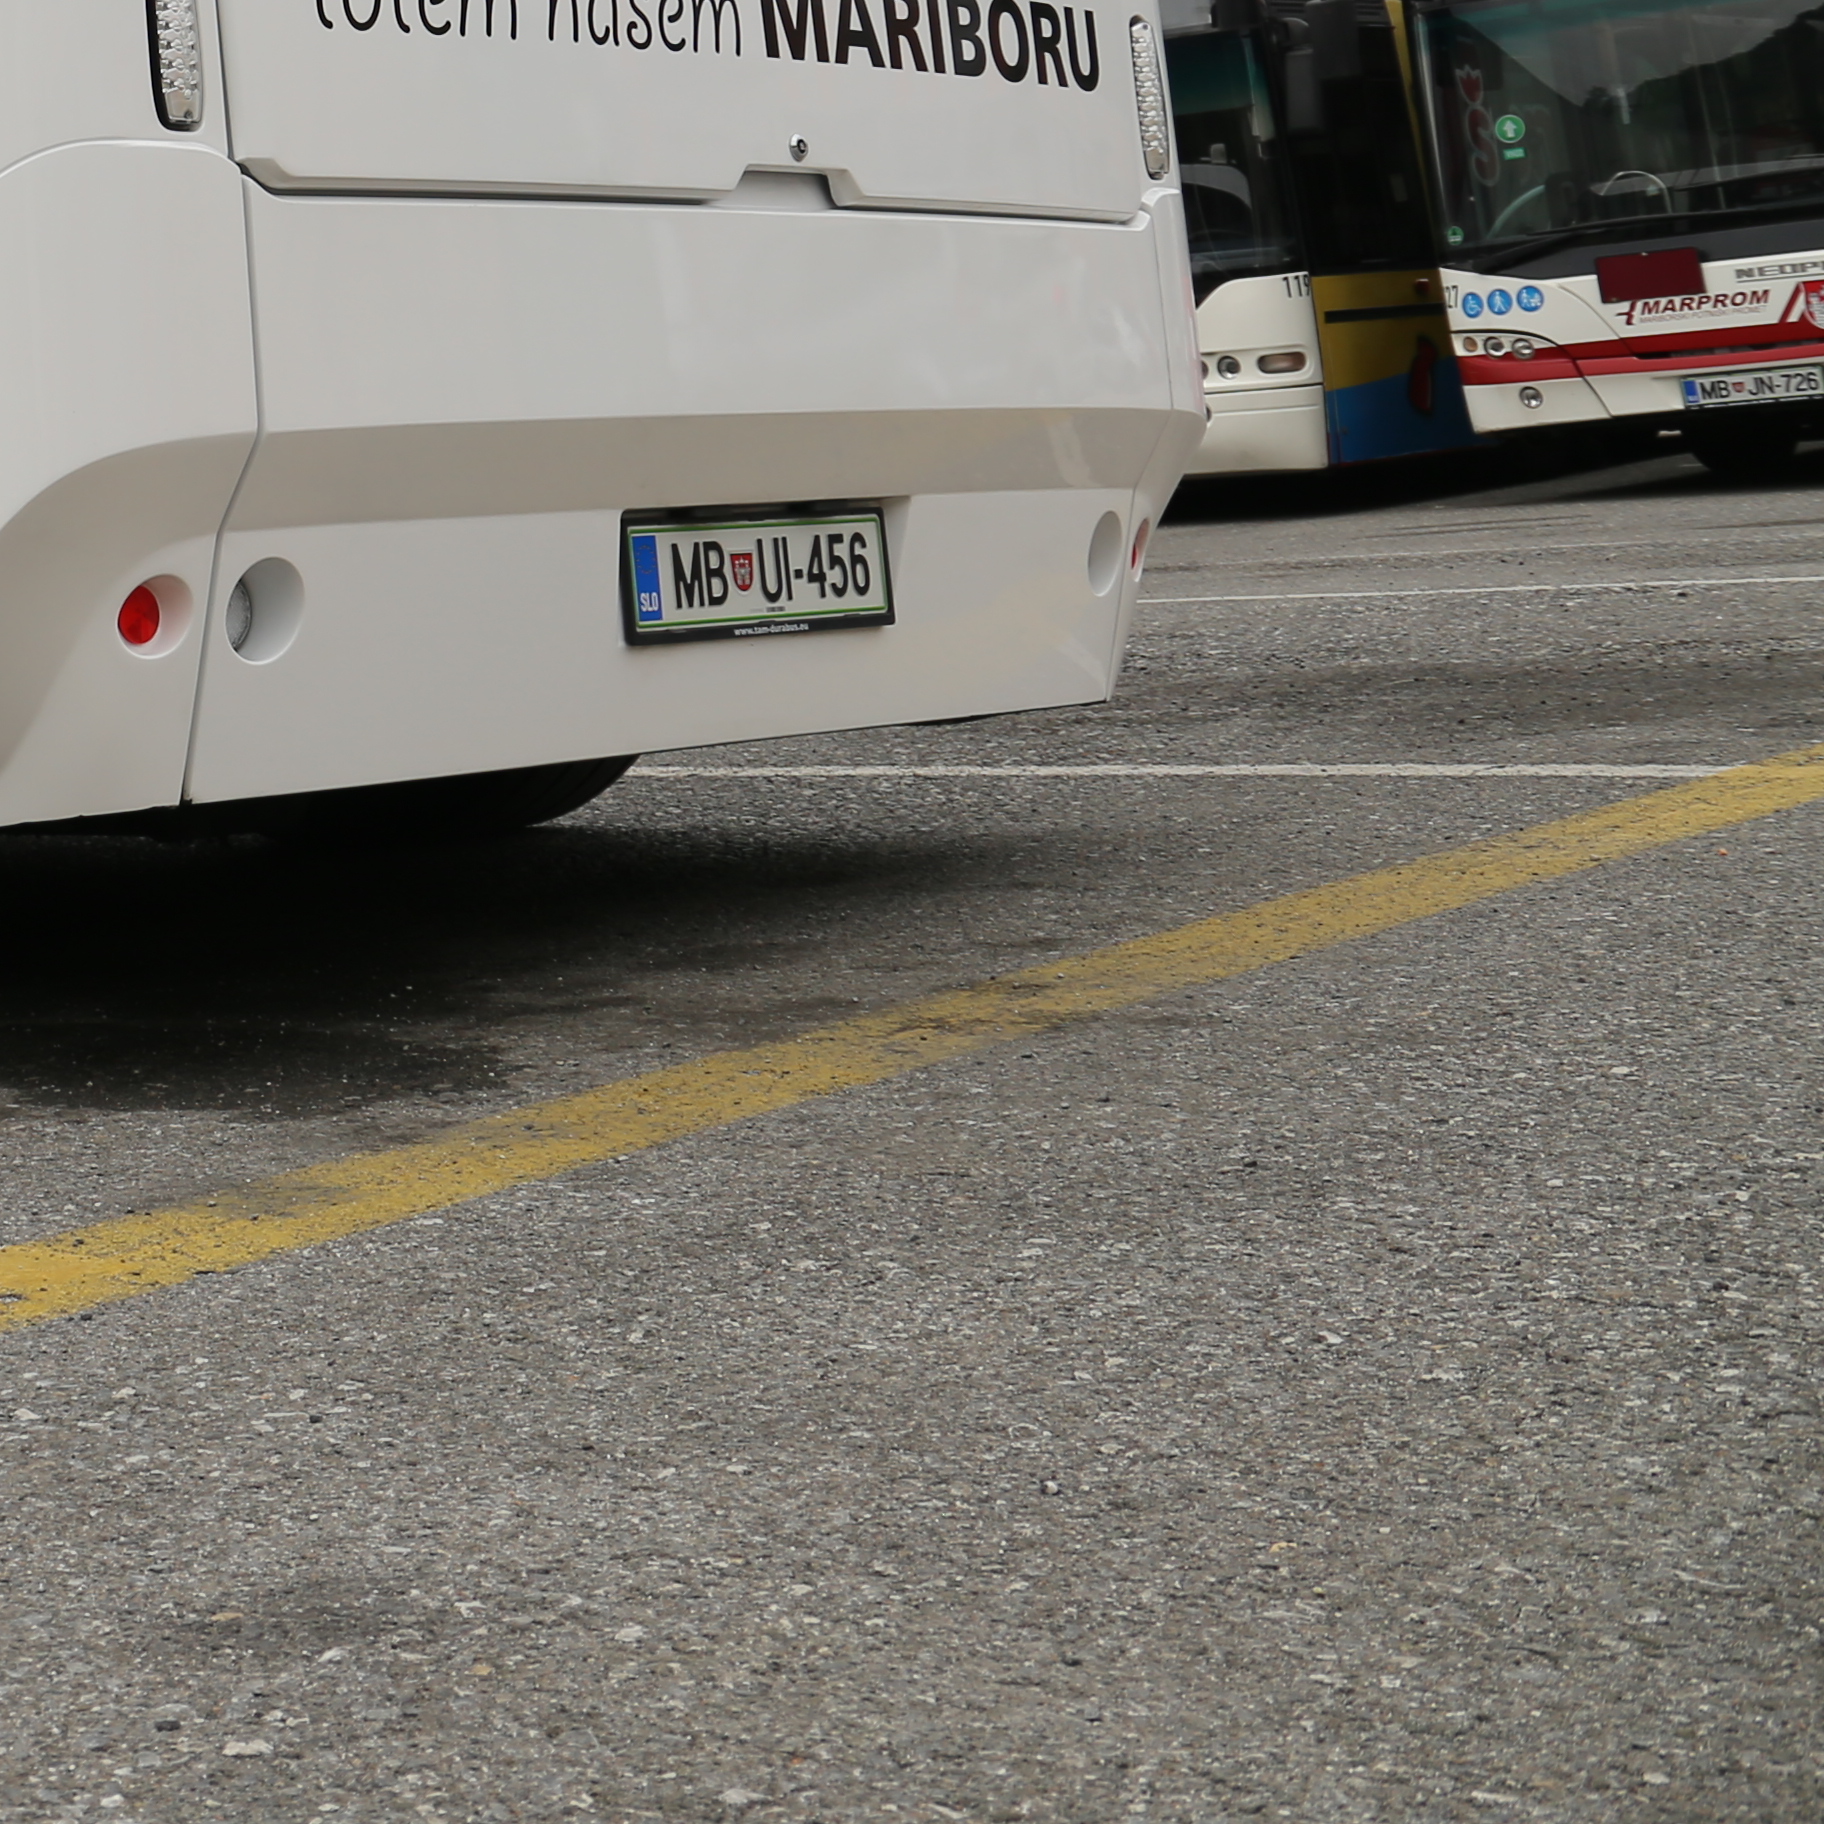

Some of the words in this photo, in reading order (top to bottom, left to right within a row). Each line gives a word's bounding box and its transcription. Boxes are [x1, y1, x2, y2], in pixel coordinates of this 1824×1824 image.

[1282, 274, 1310, 298] 119
[1640, 289, 1770, 316] MARPROM
[1699, 380, 1730, 400] MB
[1749, 372, 1819, 396] JN-726
[671, 540, 729, 609] MB
[756, 531, 871, 603] UI-456
[640, 592, 659, 612] SLO
